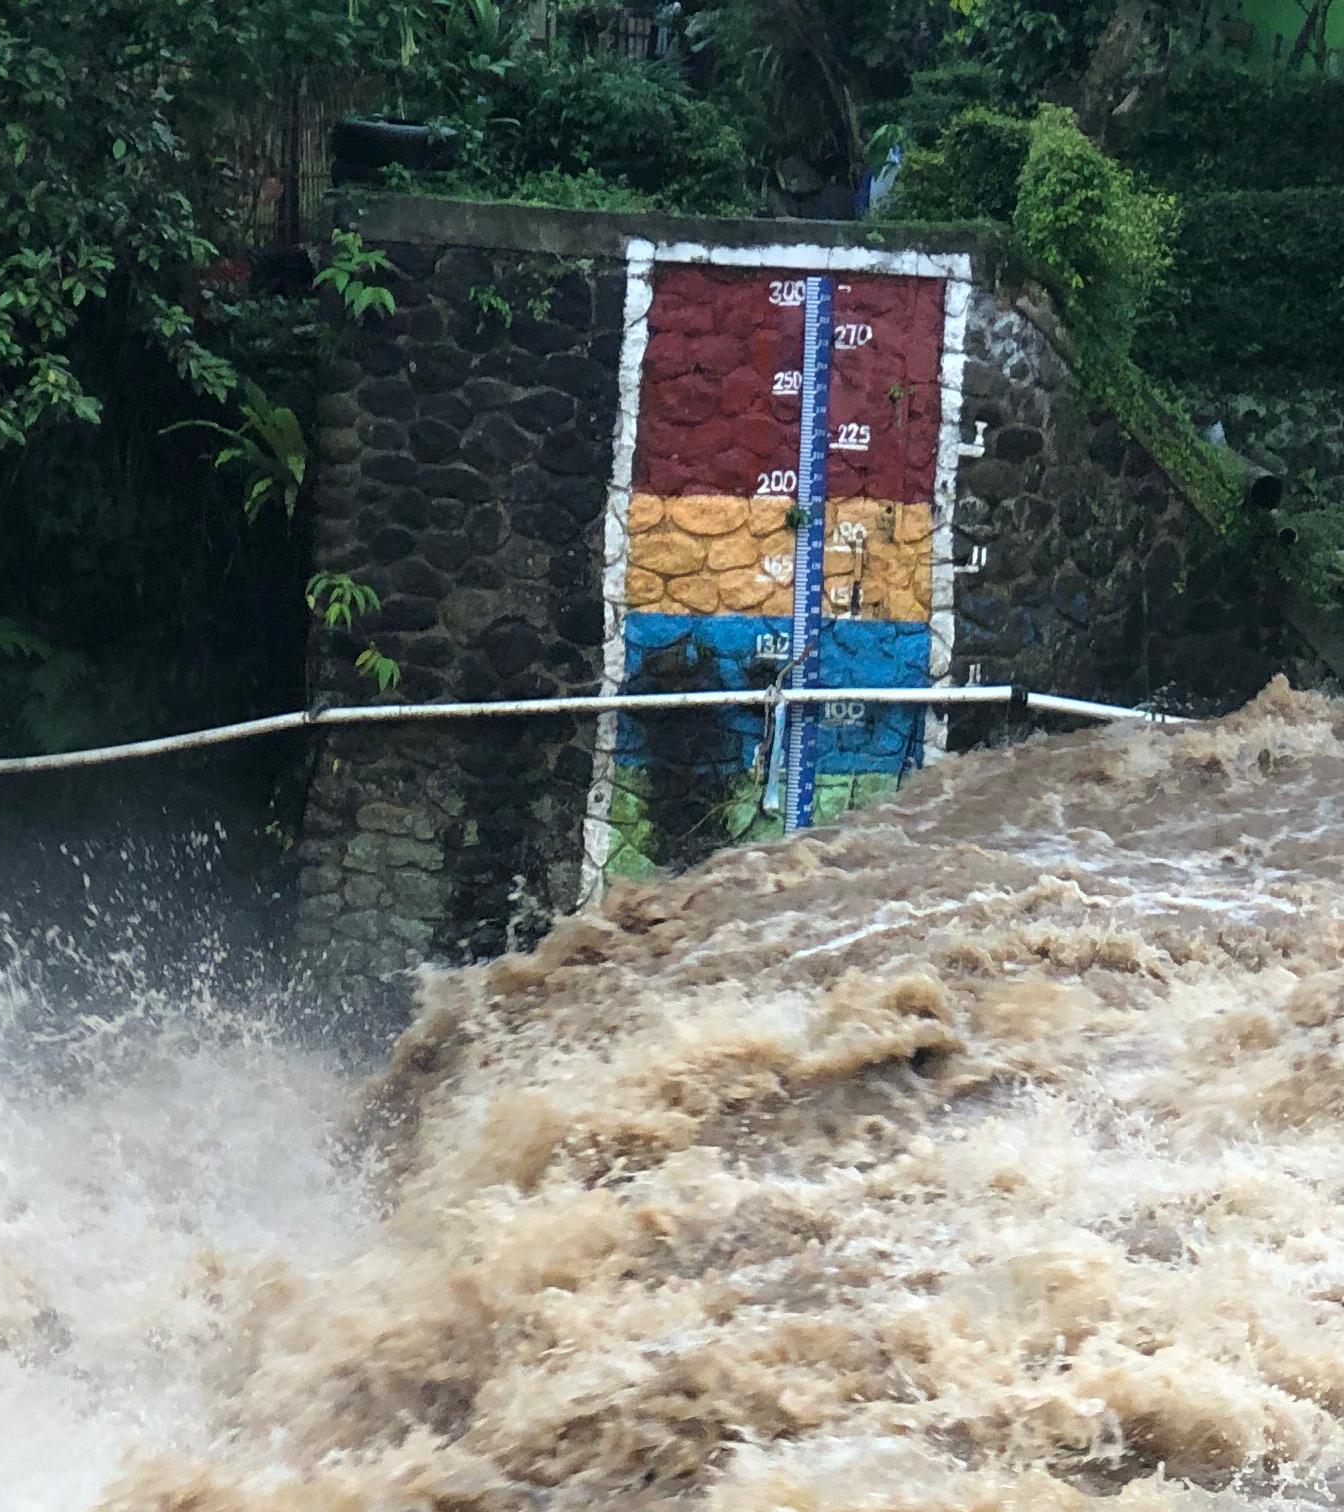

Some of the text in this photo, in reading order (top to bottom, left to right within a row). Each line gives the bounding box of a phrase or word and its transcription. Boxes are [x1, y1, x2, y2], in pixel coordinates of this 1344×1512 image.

[768, 280, 806, 304] 300
[835, 323, 873, 346] 270
[773, 371, 802, 391] 250
[838, 423, 870, 444] 225
[757, 471, 797, 494] 200
[756, 632, 789, 653] 130
[824, 702, 866, 719] 100
